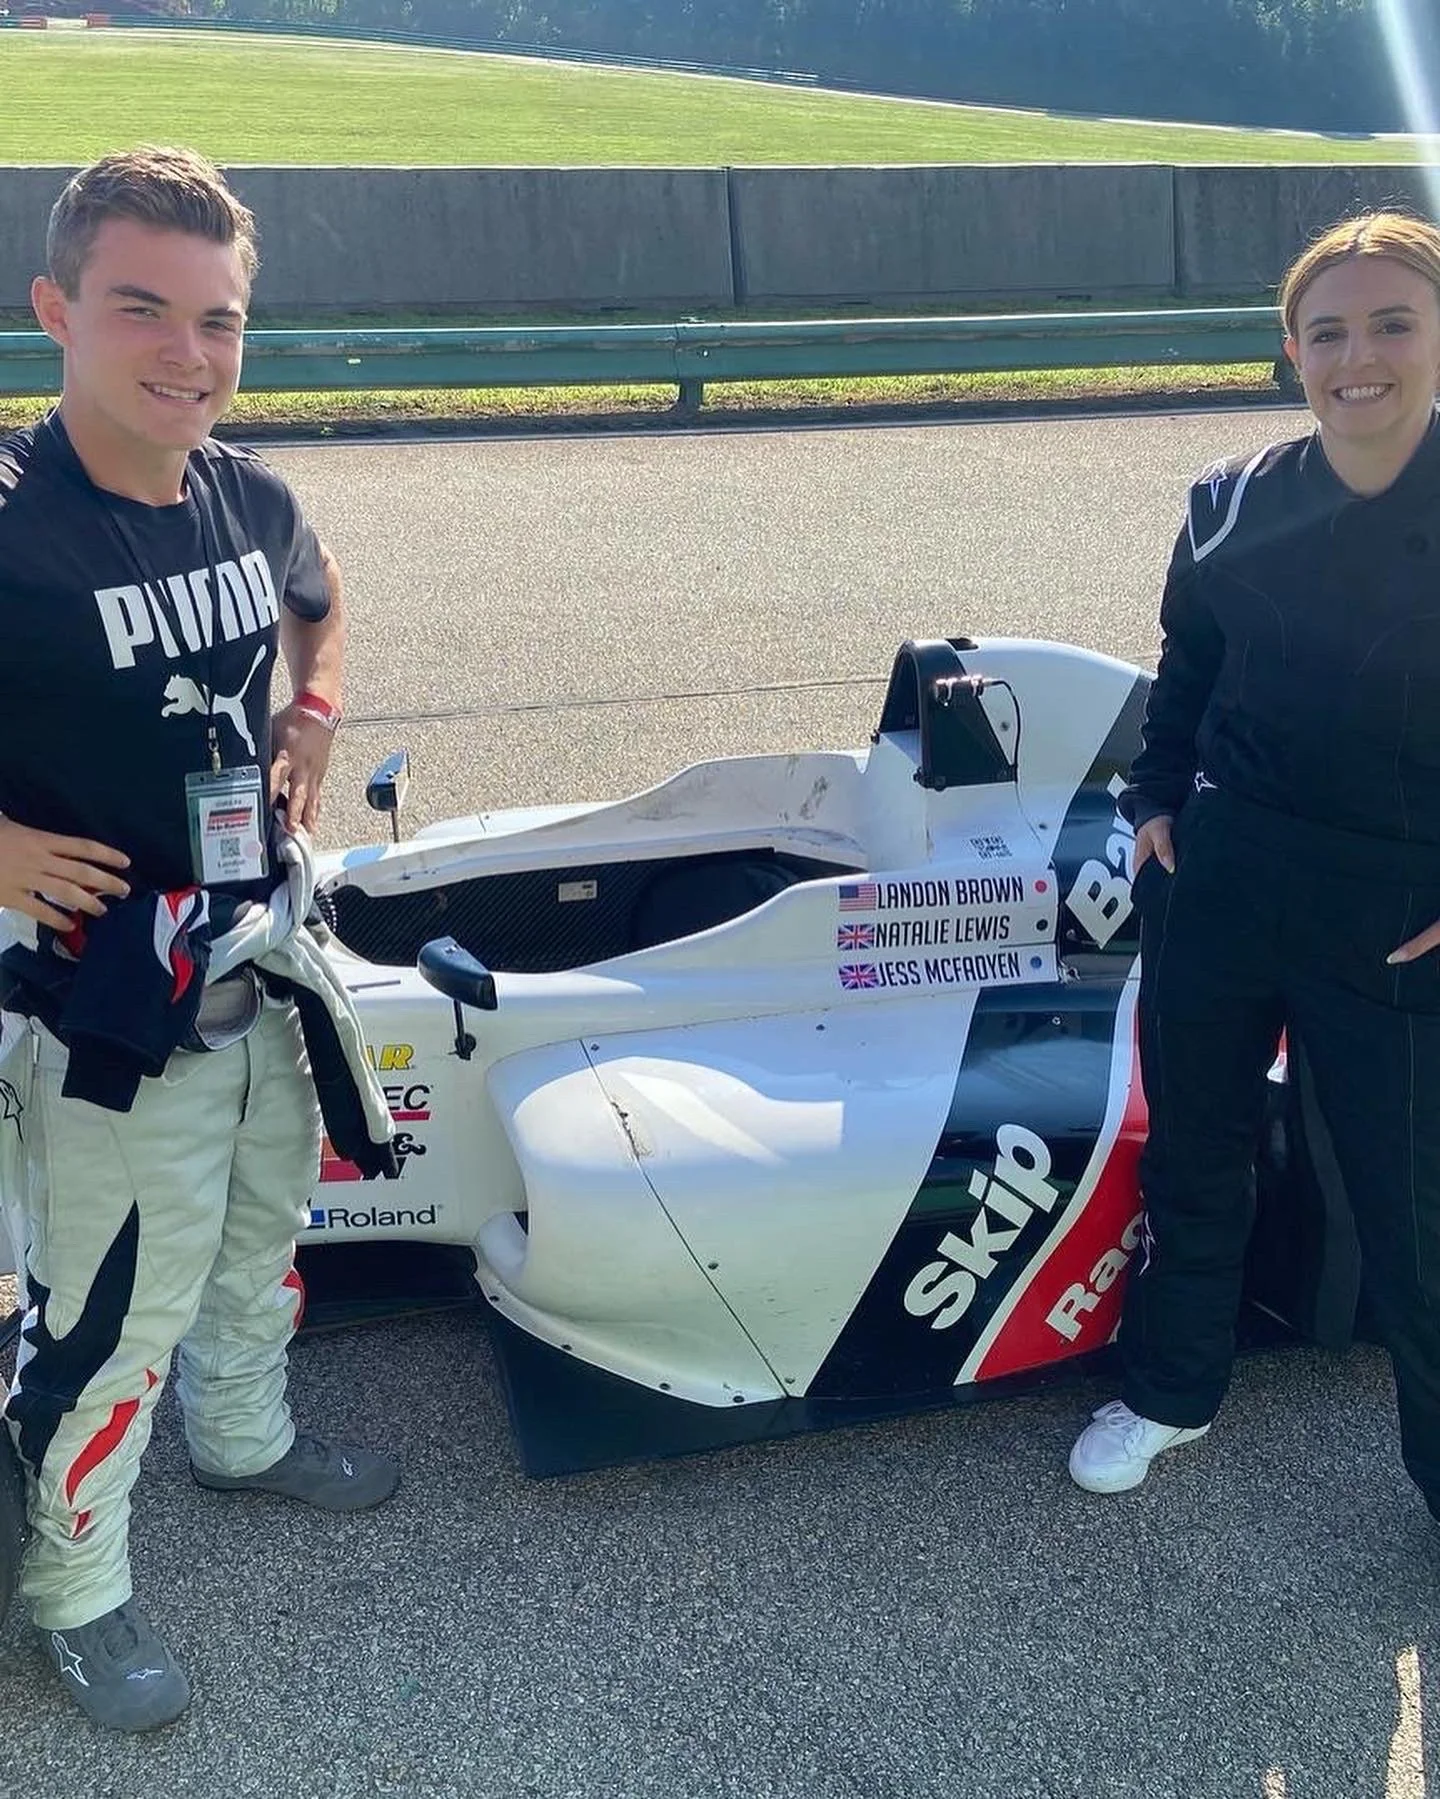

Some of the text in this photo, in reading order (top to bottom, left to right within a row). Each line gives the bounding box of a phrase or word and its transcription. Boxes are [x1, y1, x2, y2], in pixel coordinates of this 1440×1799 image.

[94, 550, 280, 670] PUMA
[876, 876, 1024, 909] LANDON BROWN
[875, 915, 1010, 948] NATALIE LEWIS
[877, 952, 1021, 987] JESS MCFADYEN
[328, 1204, 437, 1229] Roland
[903, 1123, 1060, 1330] Skip
